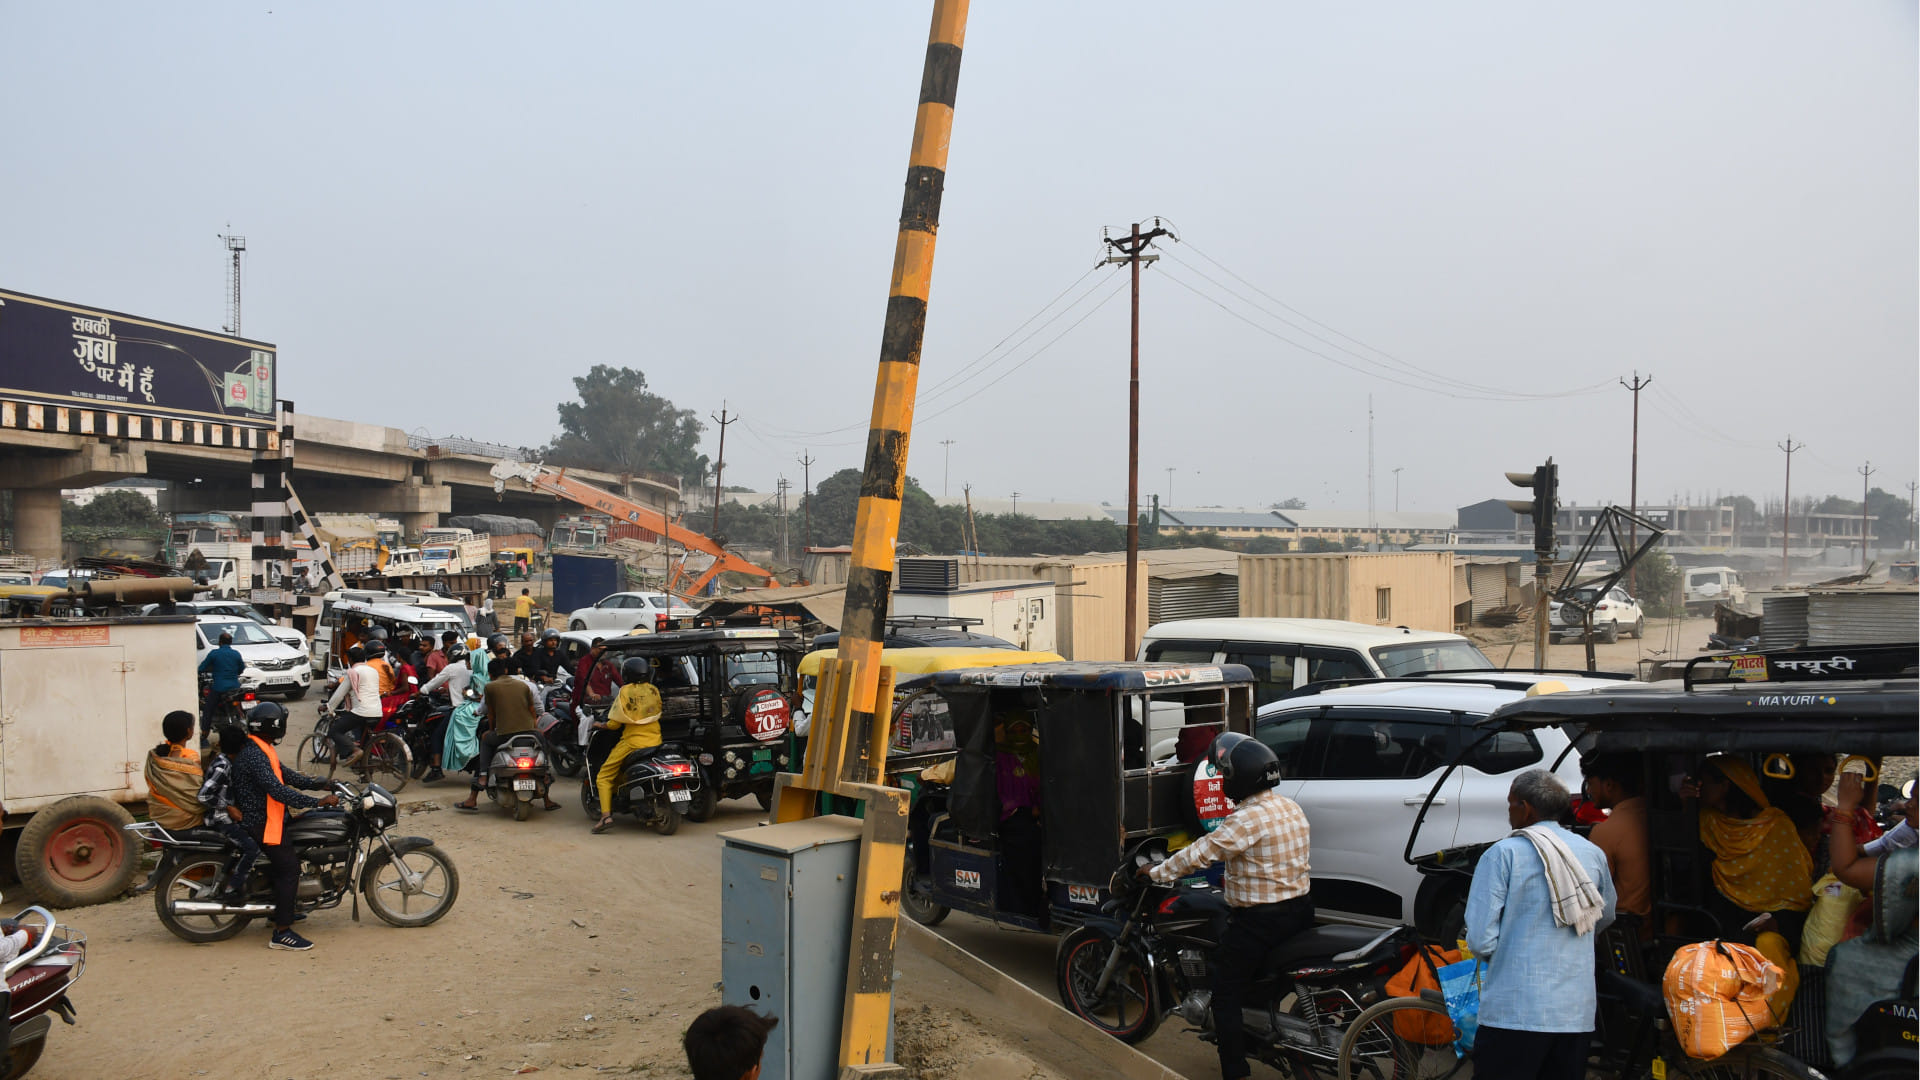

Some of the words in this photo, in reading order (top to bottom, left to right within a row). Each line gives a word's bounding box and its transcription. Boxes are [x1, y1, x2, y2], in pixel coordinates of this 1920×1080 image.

[72, 316, 110, 336] सबकी
[96, 367, 114, 383] पर
[117, 362, 135, 392] मैं
[139, 366, 155, 403] हूँ
[1774, 656, 1856, 674] मयूरी
[1145, 668, 1192, 685] SAV
[1758, 695, 1816, 706] MAYURI
[956, 870, 980, 884] SAV
[1069, 885, 1098, 900] SAV
